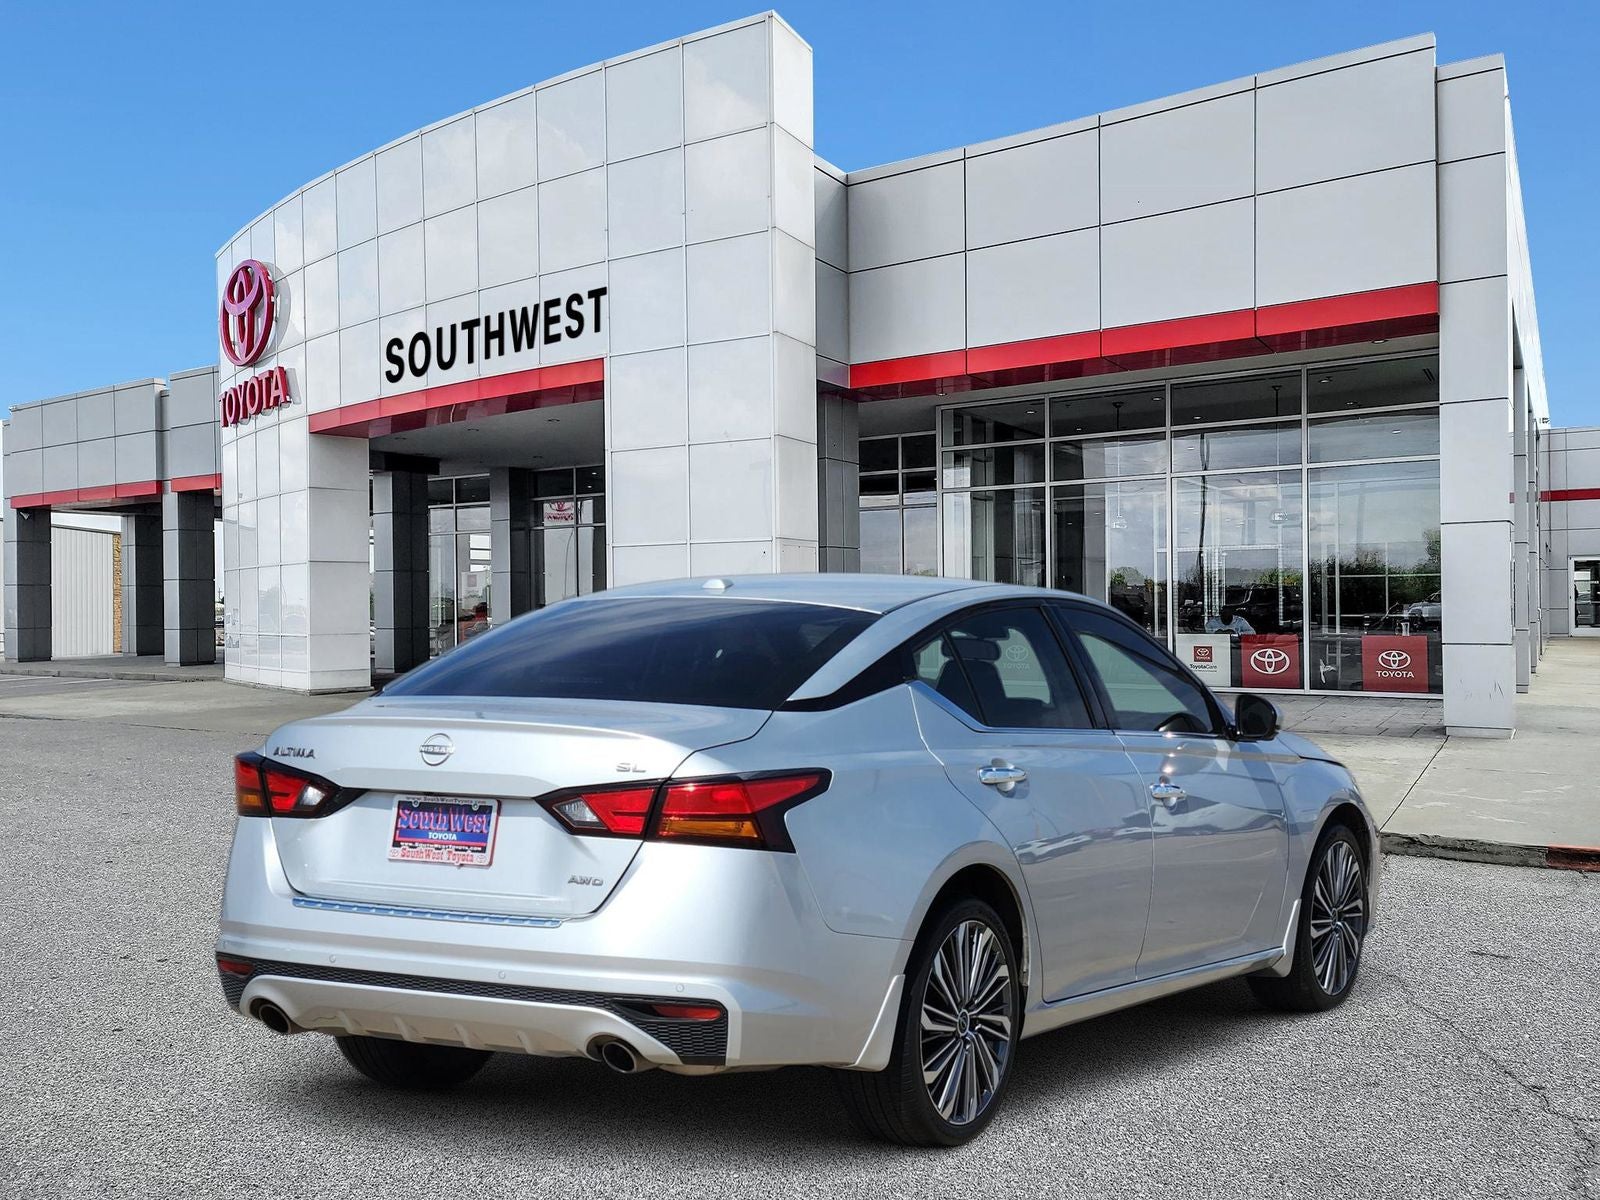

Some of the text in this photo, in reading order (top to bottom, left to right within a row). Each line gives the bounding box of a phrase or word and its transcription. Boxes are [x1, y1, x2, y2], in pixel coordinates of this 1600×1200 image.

[385, 286, 608, 383] SOUTHWEST
[218, 366, 291, 427] TOYOTA
[1375, 670, 1415, 678] TOYOTA
[273, 746, 315, 759] ALTIMA
[420, 745, 454, 754] NISSAN
[616, 762, 646, 772] SL
[428, 832, 457, 841] TOYOTA
[447, 850, 474, 864] Toyota
[568, 875, 603, 886] AWD
